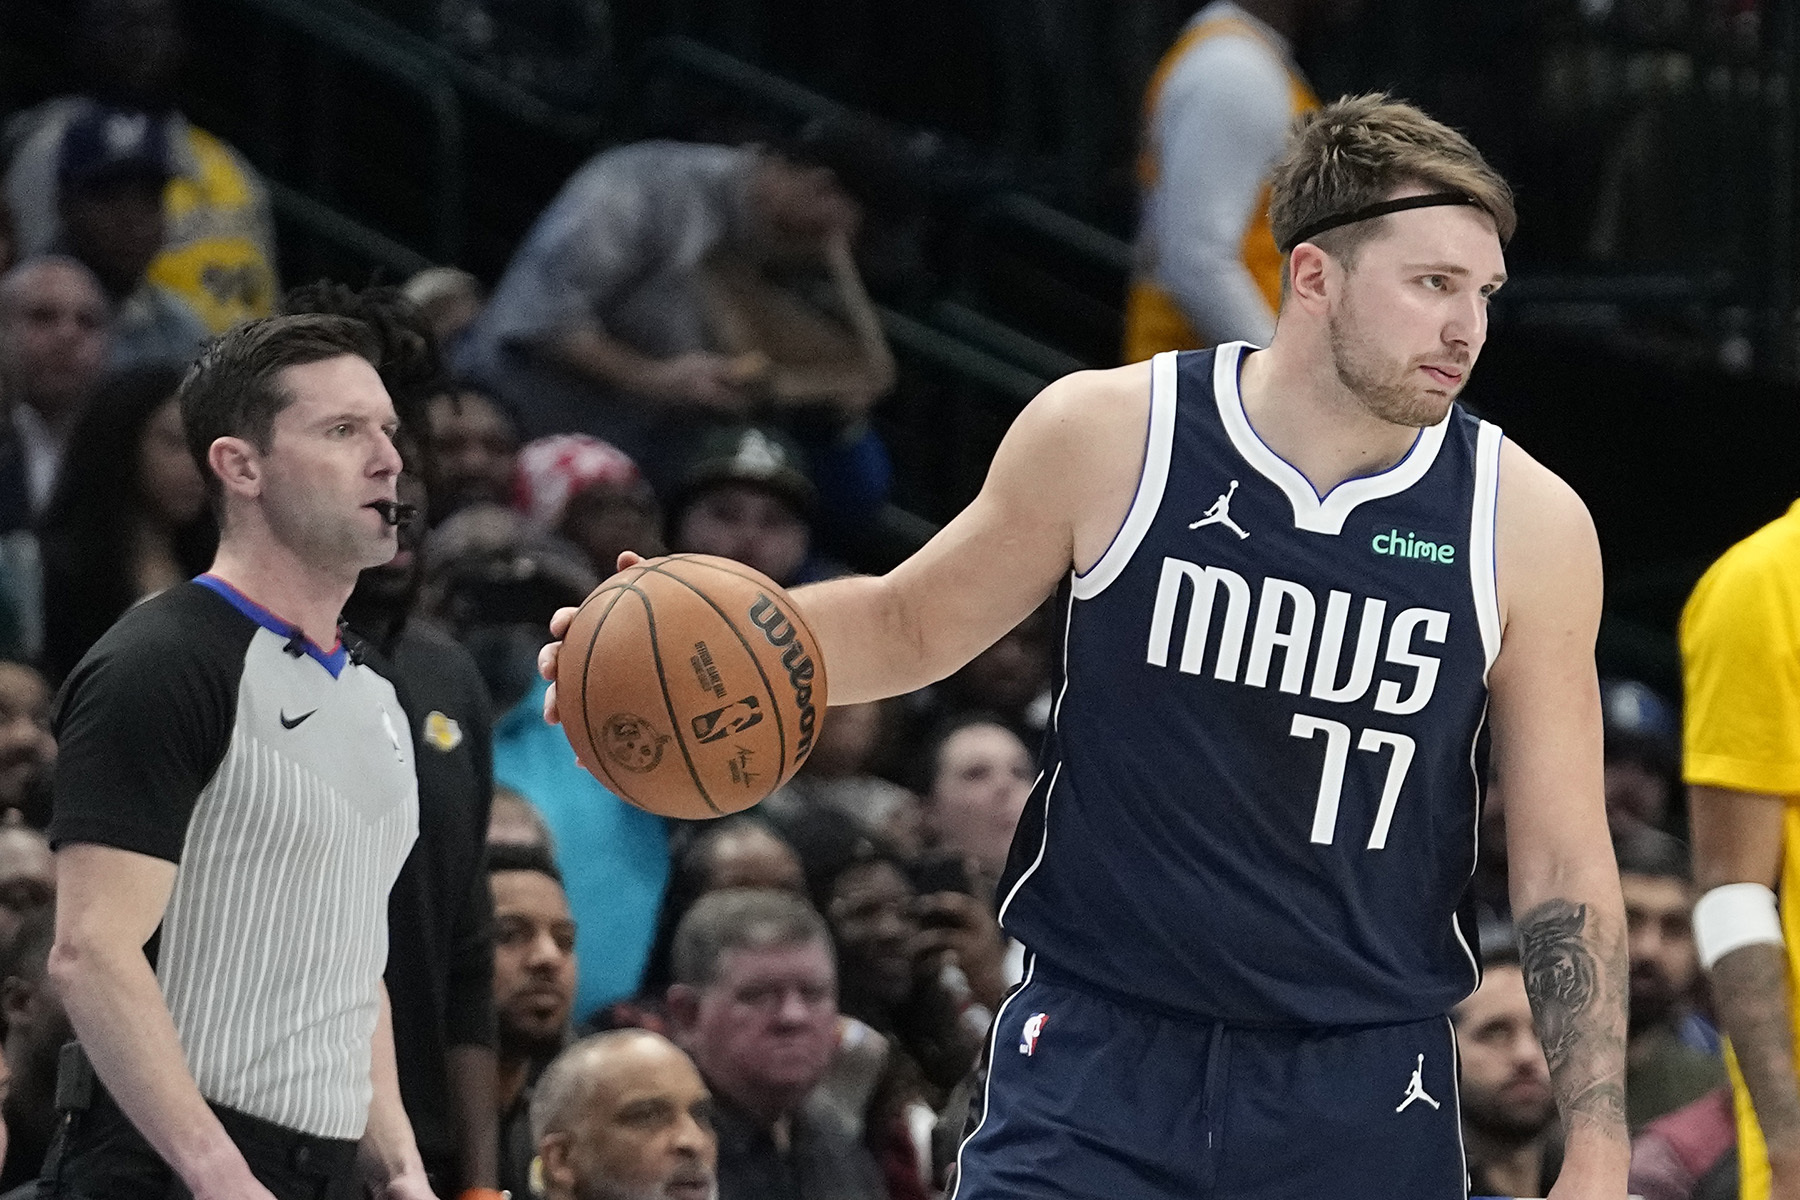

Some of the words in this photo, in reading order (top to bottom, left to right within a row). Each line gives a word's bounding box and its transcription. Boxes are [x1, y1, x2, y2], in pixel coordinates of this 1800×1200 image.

[1372, 529, 1455, 564] chime
[749, 591, 814, 766] Wilson
[1147, 556, 1450, 715] MAVS
[1290, 713, 1416, 850] 77
